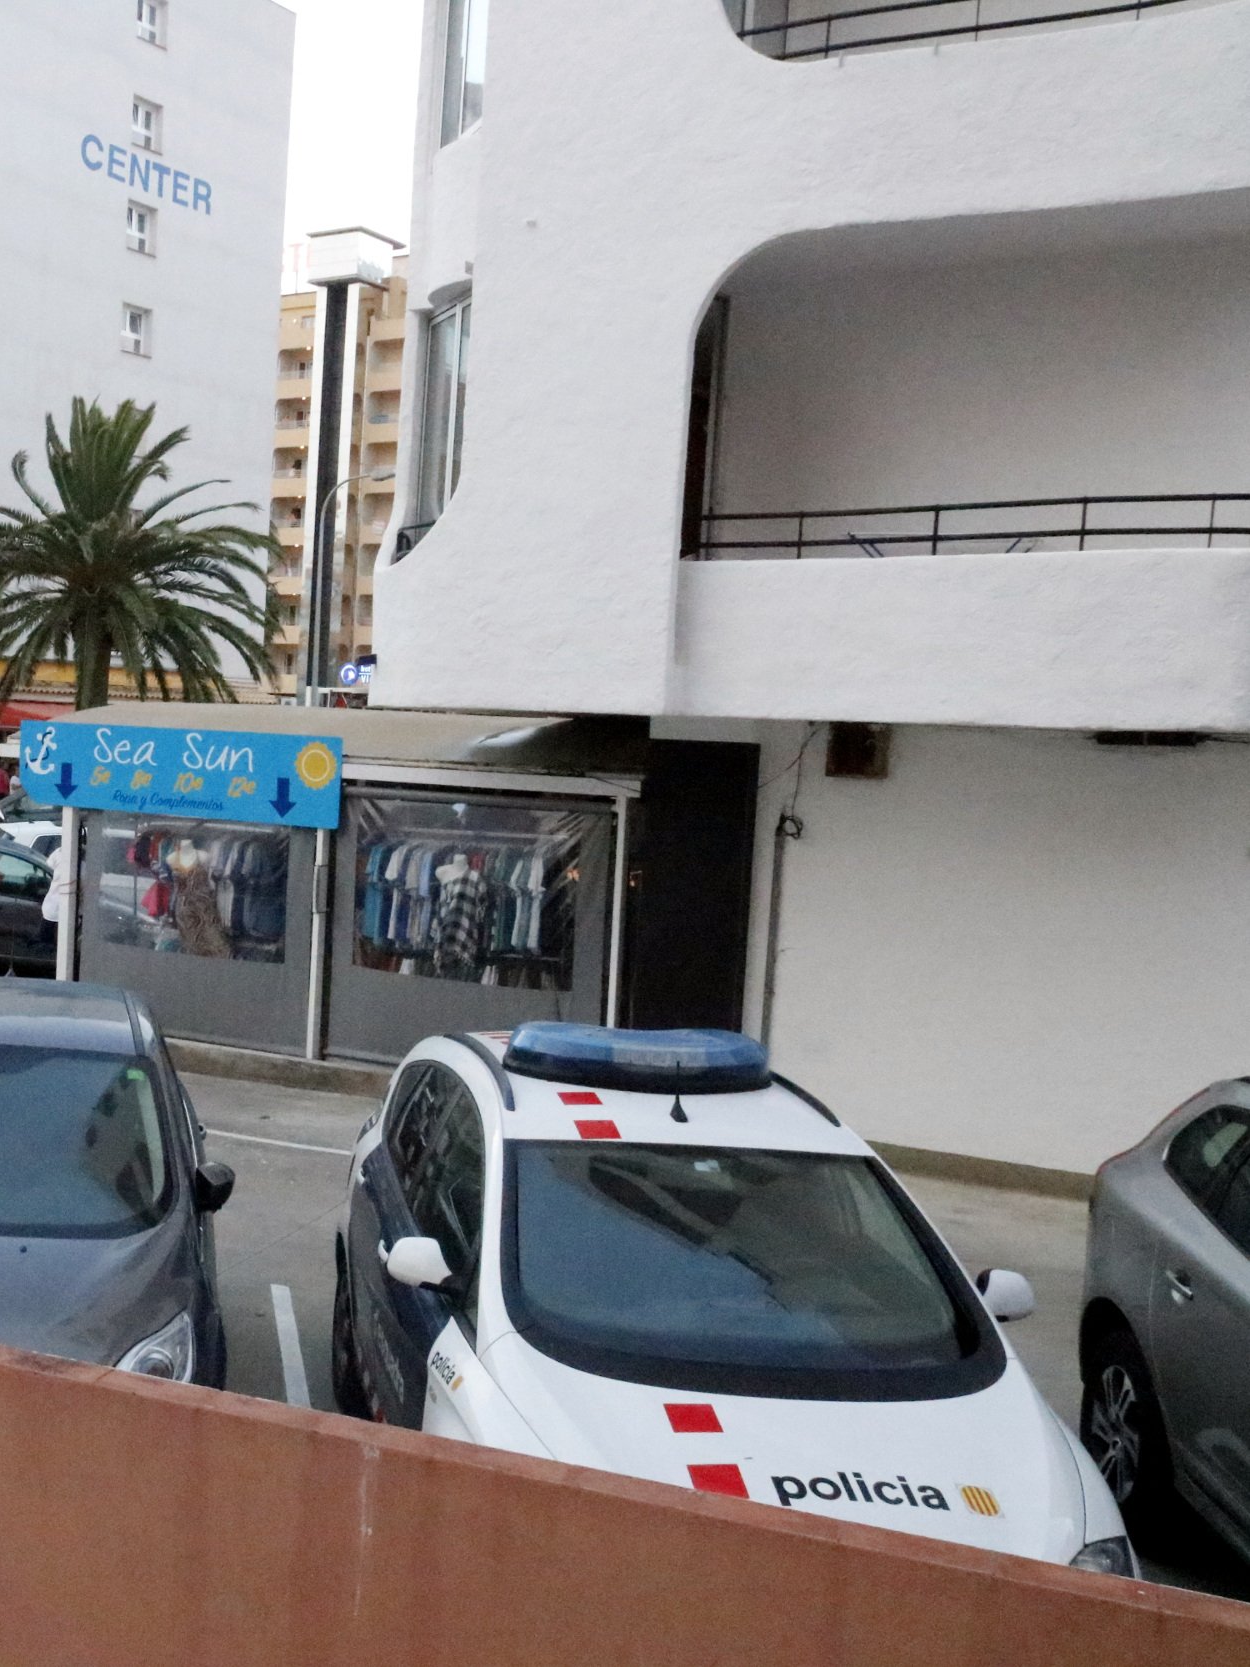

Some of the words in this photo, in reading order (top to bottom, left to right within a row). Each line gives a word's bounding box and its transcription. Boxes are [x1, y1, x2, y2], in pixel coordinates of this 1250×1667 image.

[81, 134, 212, 215] CENTER
[93, 727, 158, 767] Sea
[182, 732, 254, 773] Sun
[113, 790, 137, 806] Ropa
[138, 797, 149, 810] y
[150, 792, 224, 811] Complementos
[770, 1471, 951, 1511] policia
